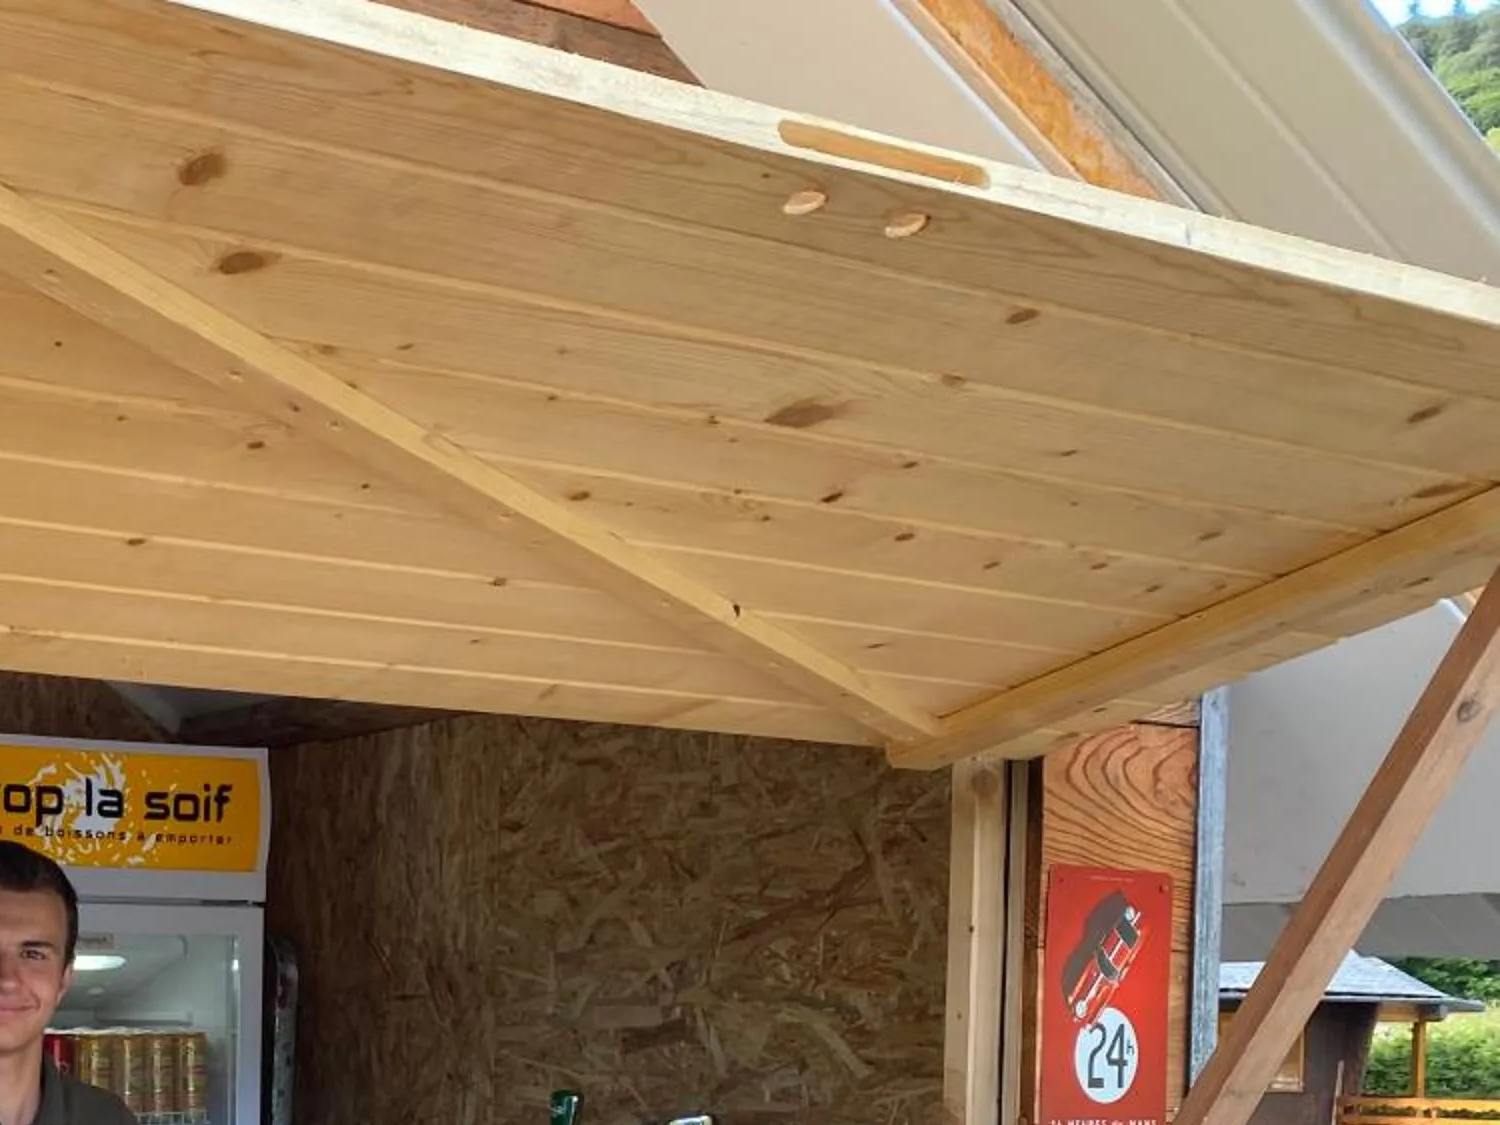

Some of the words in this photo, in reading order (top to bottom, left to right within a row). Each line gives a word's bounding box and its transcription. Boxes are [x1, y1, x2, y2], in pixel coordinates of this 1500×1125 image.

[86, 777, 124, 818] la
[144, 784, 233, 823] soif
[14, 824, 35, 837] de
[45, 826, 127, 841] boissons
[155, 832, 232, 845] emporter
